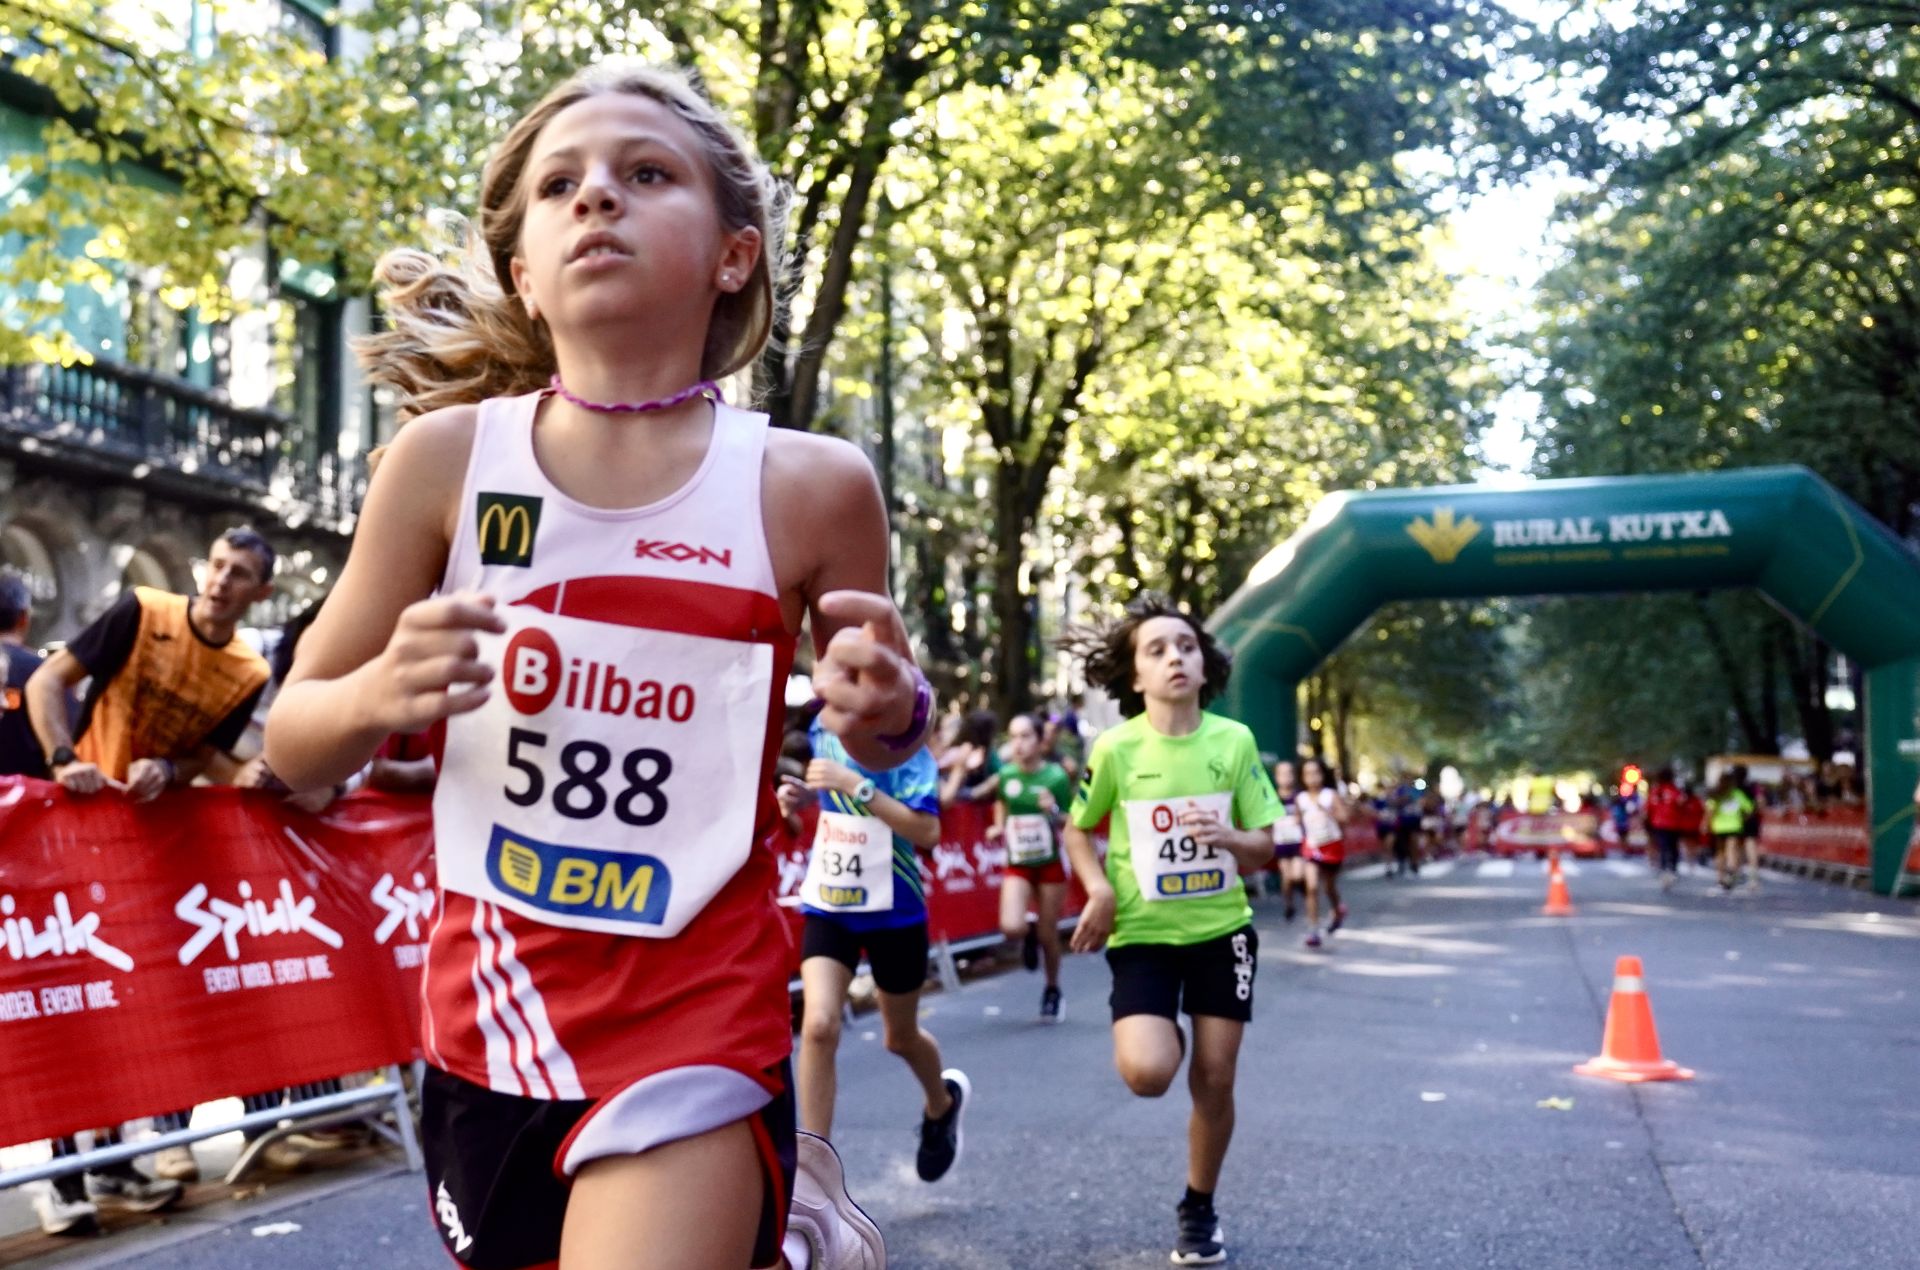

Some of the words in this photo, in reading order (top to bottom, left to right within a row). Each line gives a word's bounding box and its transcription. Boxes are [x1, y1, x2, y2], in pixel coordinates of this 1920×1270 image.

[1493, 517, 1602, 548] RURAL
[1608, 509, 1732, 542] KUTXA
[507, 634, 695, 723] Bilbao
[504, 726, 673, 827] 588
[548, 857, 654, 913] BM
[1185, 871, 1221, 892] BM
[174, 878, 344, 967] Spiuk
[40, 984, 84, 1016] EVERY
